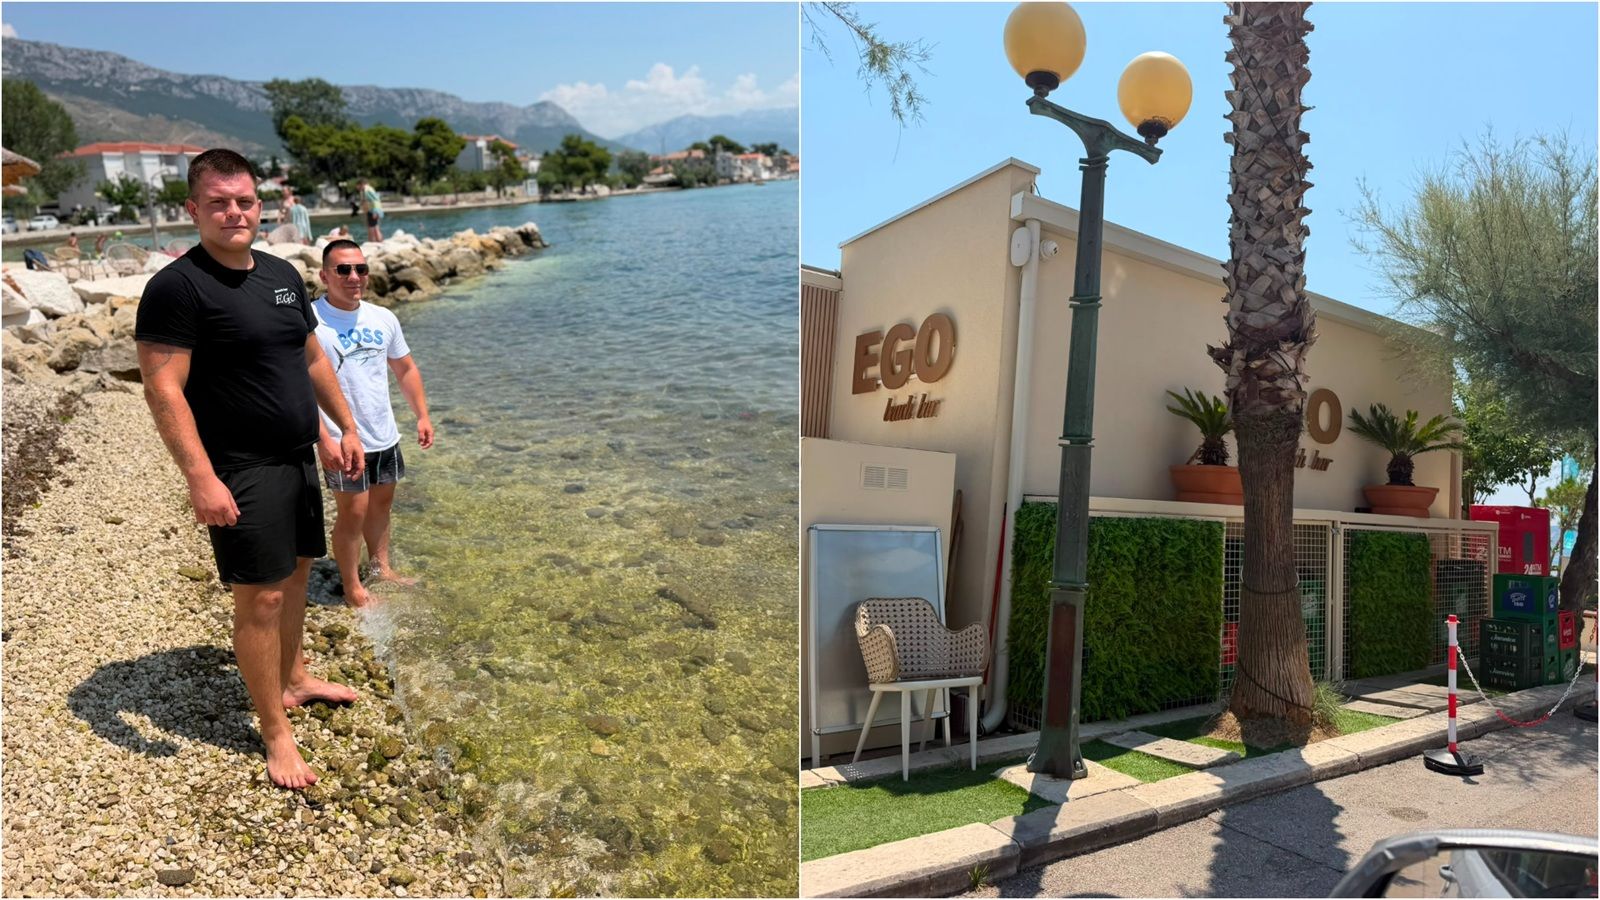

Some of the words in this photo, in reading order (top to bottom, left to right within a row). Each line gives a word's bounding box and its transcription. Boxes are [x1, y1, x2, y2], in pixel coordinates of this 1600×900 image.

[276, 292, 296, 305] EGO
[337, 328, 383, 349] BOSS
[852, 312, 956, 395] EGO
[916, 393, 942, 418] bar
[1311, 449, 1334, 471] bar
[1498, 546, 1512, 555] TM
